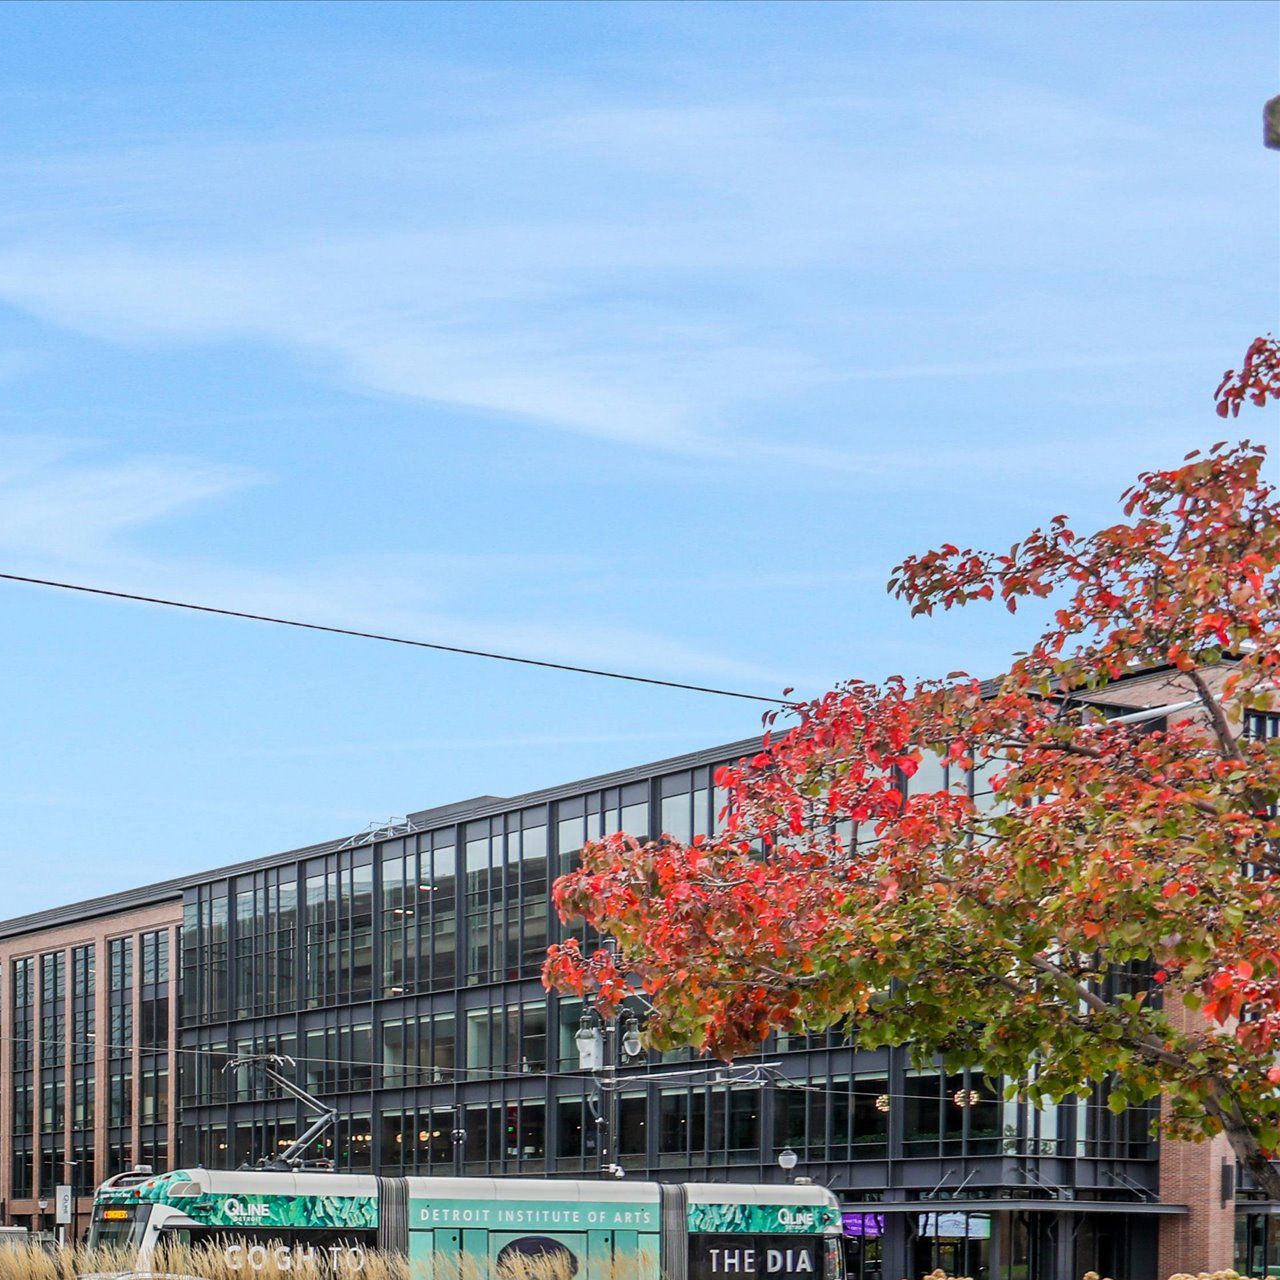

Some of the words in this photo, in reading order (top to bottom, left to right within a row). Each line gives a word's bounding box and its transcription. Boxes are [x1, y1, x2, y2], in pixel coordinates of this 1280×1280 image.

[420, 1208, 490, 1222] DETROIT
[498, 1210, 580, 1223] INSTITUTE
[587, 1211, 606, 1223] OF
[613, 1211, 651, 1224] ARTS
[225, 1245, 315, 1271] GOGH
[327, 1247, 365, 1272] TO
[709, 1248, 757, 1273] THE
[766, 1249, 814, 1274] DIA
